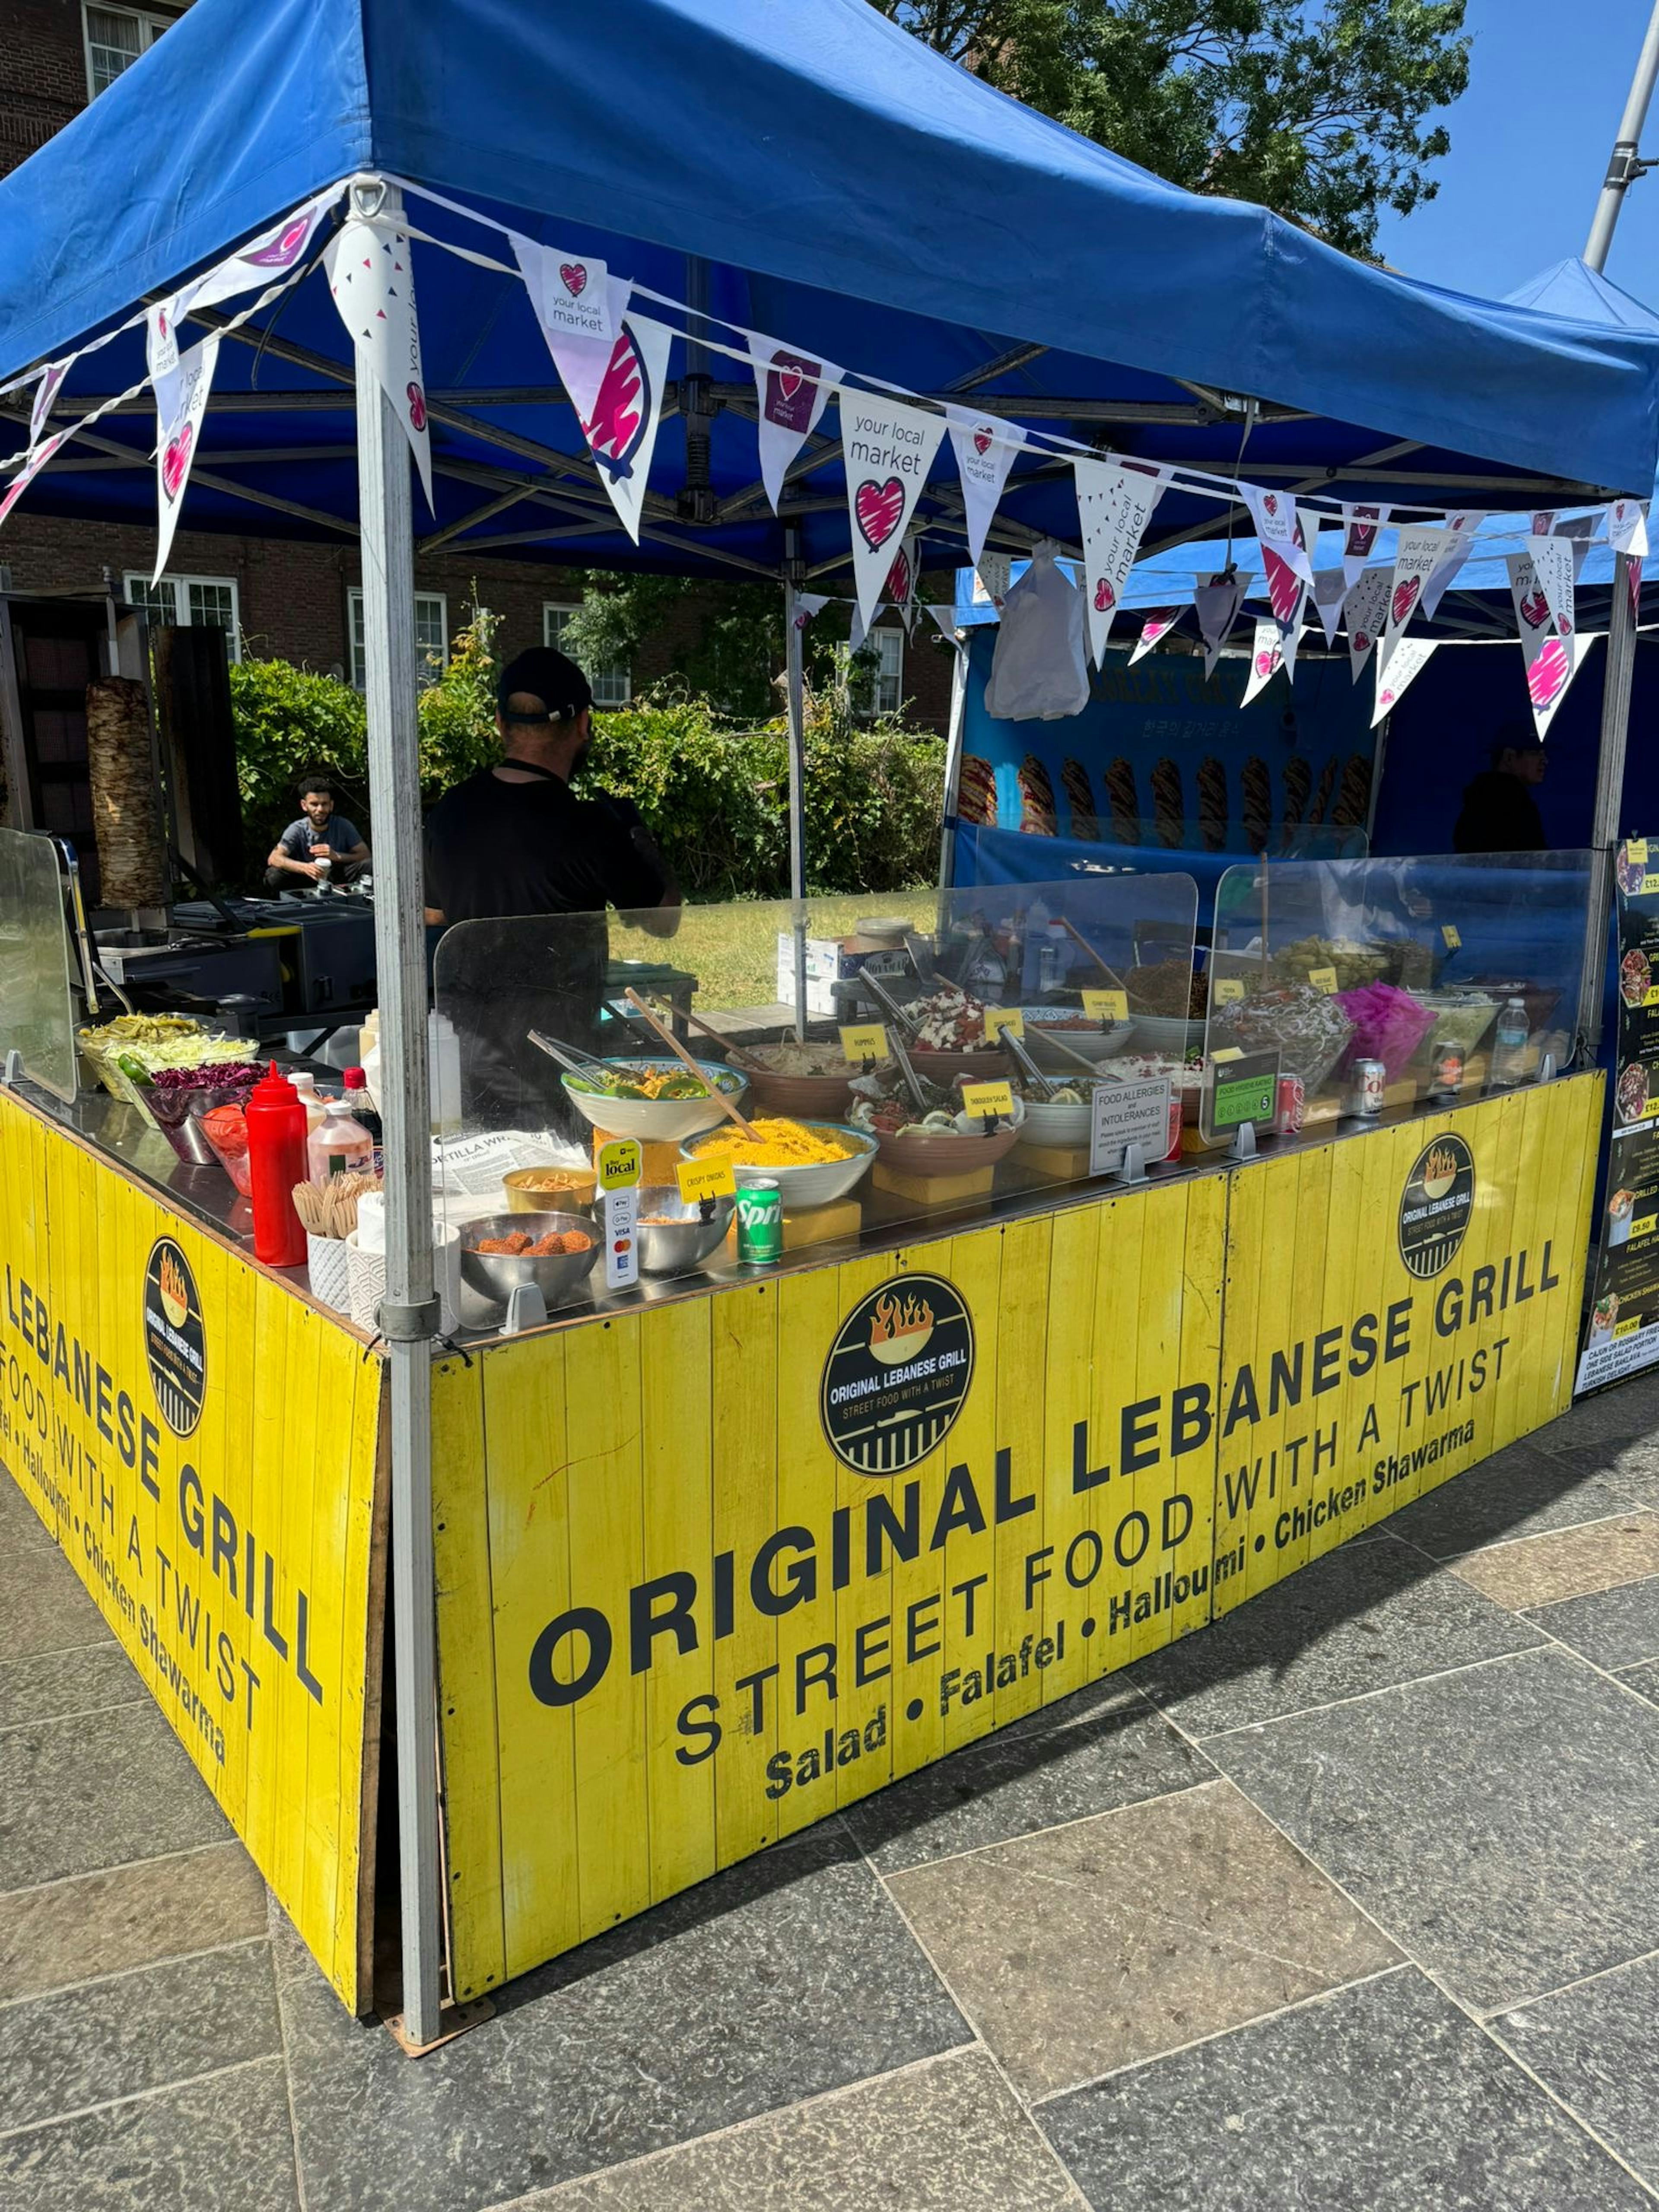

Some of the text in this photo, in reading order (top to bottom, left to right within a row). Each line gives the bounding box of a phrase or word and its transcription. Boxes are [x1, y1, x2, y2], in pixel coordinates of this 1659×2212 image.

[553, 296, 601, 316] your local
[553, 309, 604, 332] market
[855, 415, 925, 446] your local
[850, 440, 922, 475] market
[967, 467, 995, 483] market
[1104, 494, 1132, 575] your local
[1115, 502, 1147, 585] market
[1404, 541, 1421, 552] your
[1421, 540, 1440, 552] local
[1397, 555, 1433, 571] market
[1564, 556, 1573, 614] market
[1099, 1085, 1165, 1106] FOOD ALLERGIES
[1262, 1096, 1268, 1110] 5
[1101, 1106, 1160, 1127] INTOLERANCES
[606, 1158, 636, 1176] local
[686, 1171, 726, 1188] CRISPY ONIONS
[739, 1199, 781, 1230] Spri
[1403, 1192, 1470, 1225] ORIGINAL LEBANESE GRILL
[614, 1227, 630, 1236] VISA
[1615, 1321, 1639, 1335] £10.00
[1586, 1358, 1599, 1370] ONE
[1599, 1353, 1613, 1364] SIDE
[1614, 1345, 1632, 1359] SALAD
[1609, 1342, 1617, 1351] OR
[830, 1348, 966, 1405] ORIGINAL LEBANESE GRILL
[1584, 1362, 1614, 1380] LEBANESE
[842, 1373, 955, 1420] STREET FOOD WITH A TWIST
[6, 1262, 324, 1707] LEBANESE GRILL
[528, 1239, 1559, 1708] ORIGINAL LEBANESE GRILL
[675, 1337, 1510, 1766] STREET FOOD WITH A TWIST
[57, 1414, 114, 1536] WITH
[128, 1514, 144, 1579] A
[157, 1545, 261, 1732] TWIST
[22, 1431, 226, 1769] Halloumi Chicken Shawarma
[765, 1417, 1476, 1801] Salad Falafel Halloumi Chicken Shawarma
